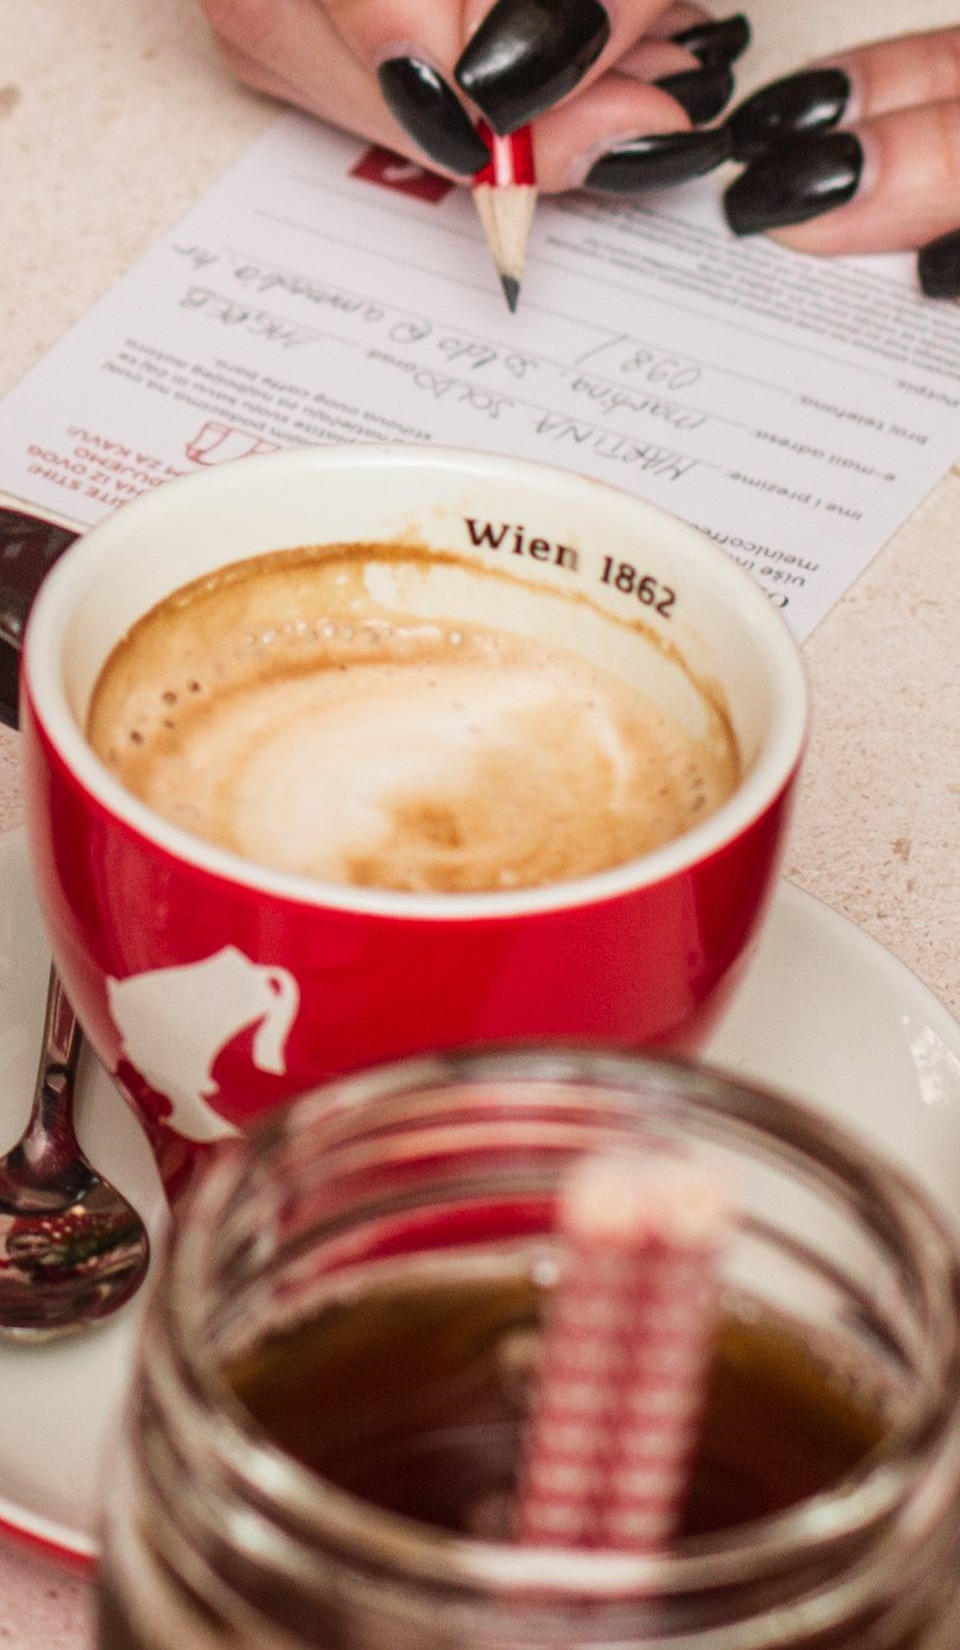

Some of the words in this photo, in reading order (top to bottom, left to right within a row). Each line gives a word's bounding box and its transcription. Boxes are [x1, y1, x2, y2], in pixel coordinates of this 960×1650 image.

[534, 409, 702, 483] MARTINA
[465, 517, 580, 573] Wien
[601, 554, 678, 619] 1862
